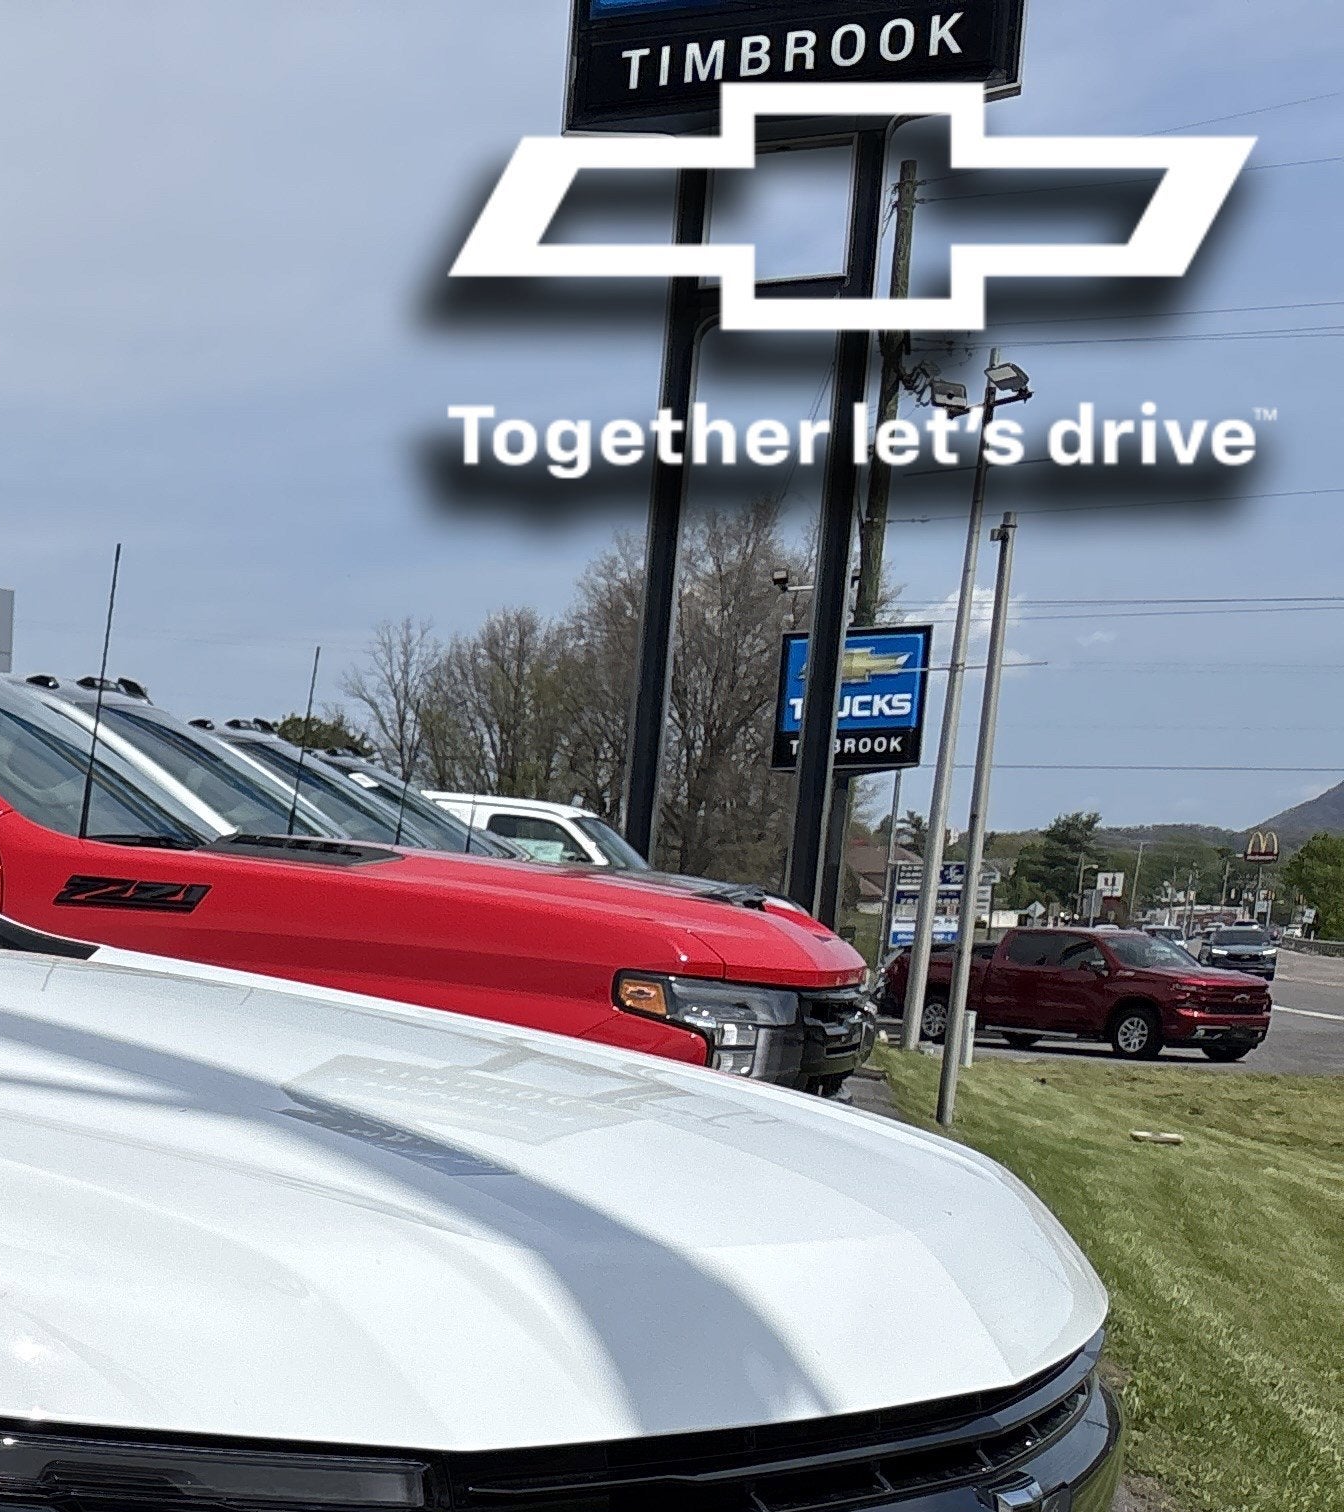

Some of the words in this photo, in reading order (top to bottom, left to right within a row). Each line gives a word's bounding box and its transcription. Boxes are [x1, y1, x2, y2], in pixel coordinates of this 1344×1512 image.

[622, 10, 965, 90] TIMBROOK
[789, 692, 912, 721] TUCKS
[789, 735, 904, 756] TBROOK
